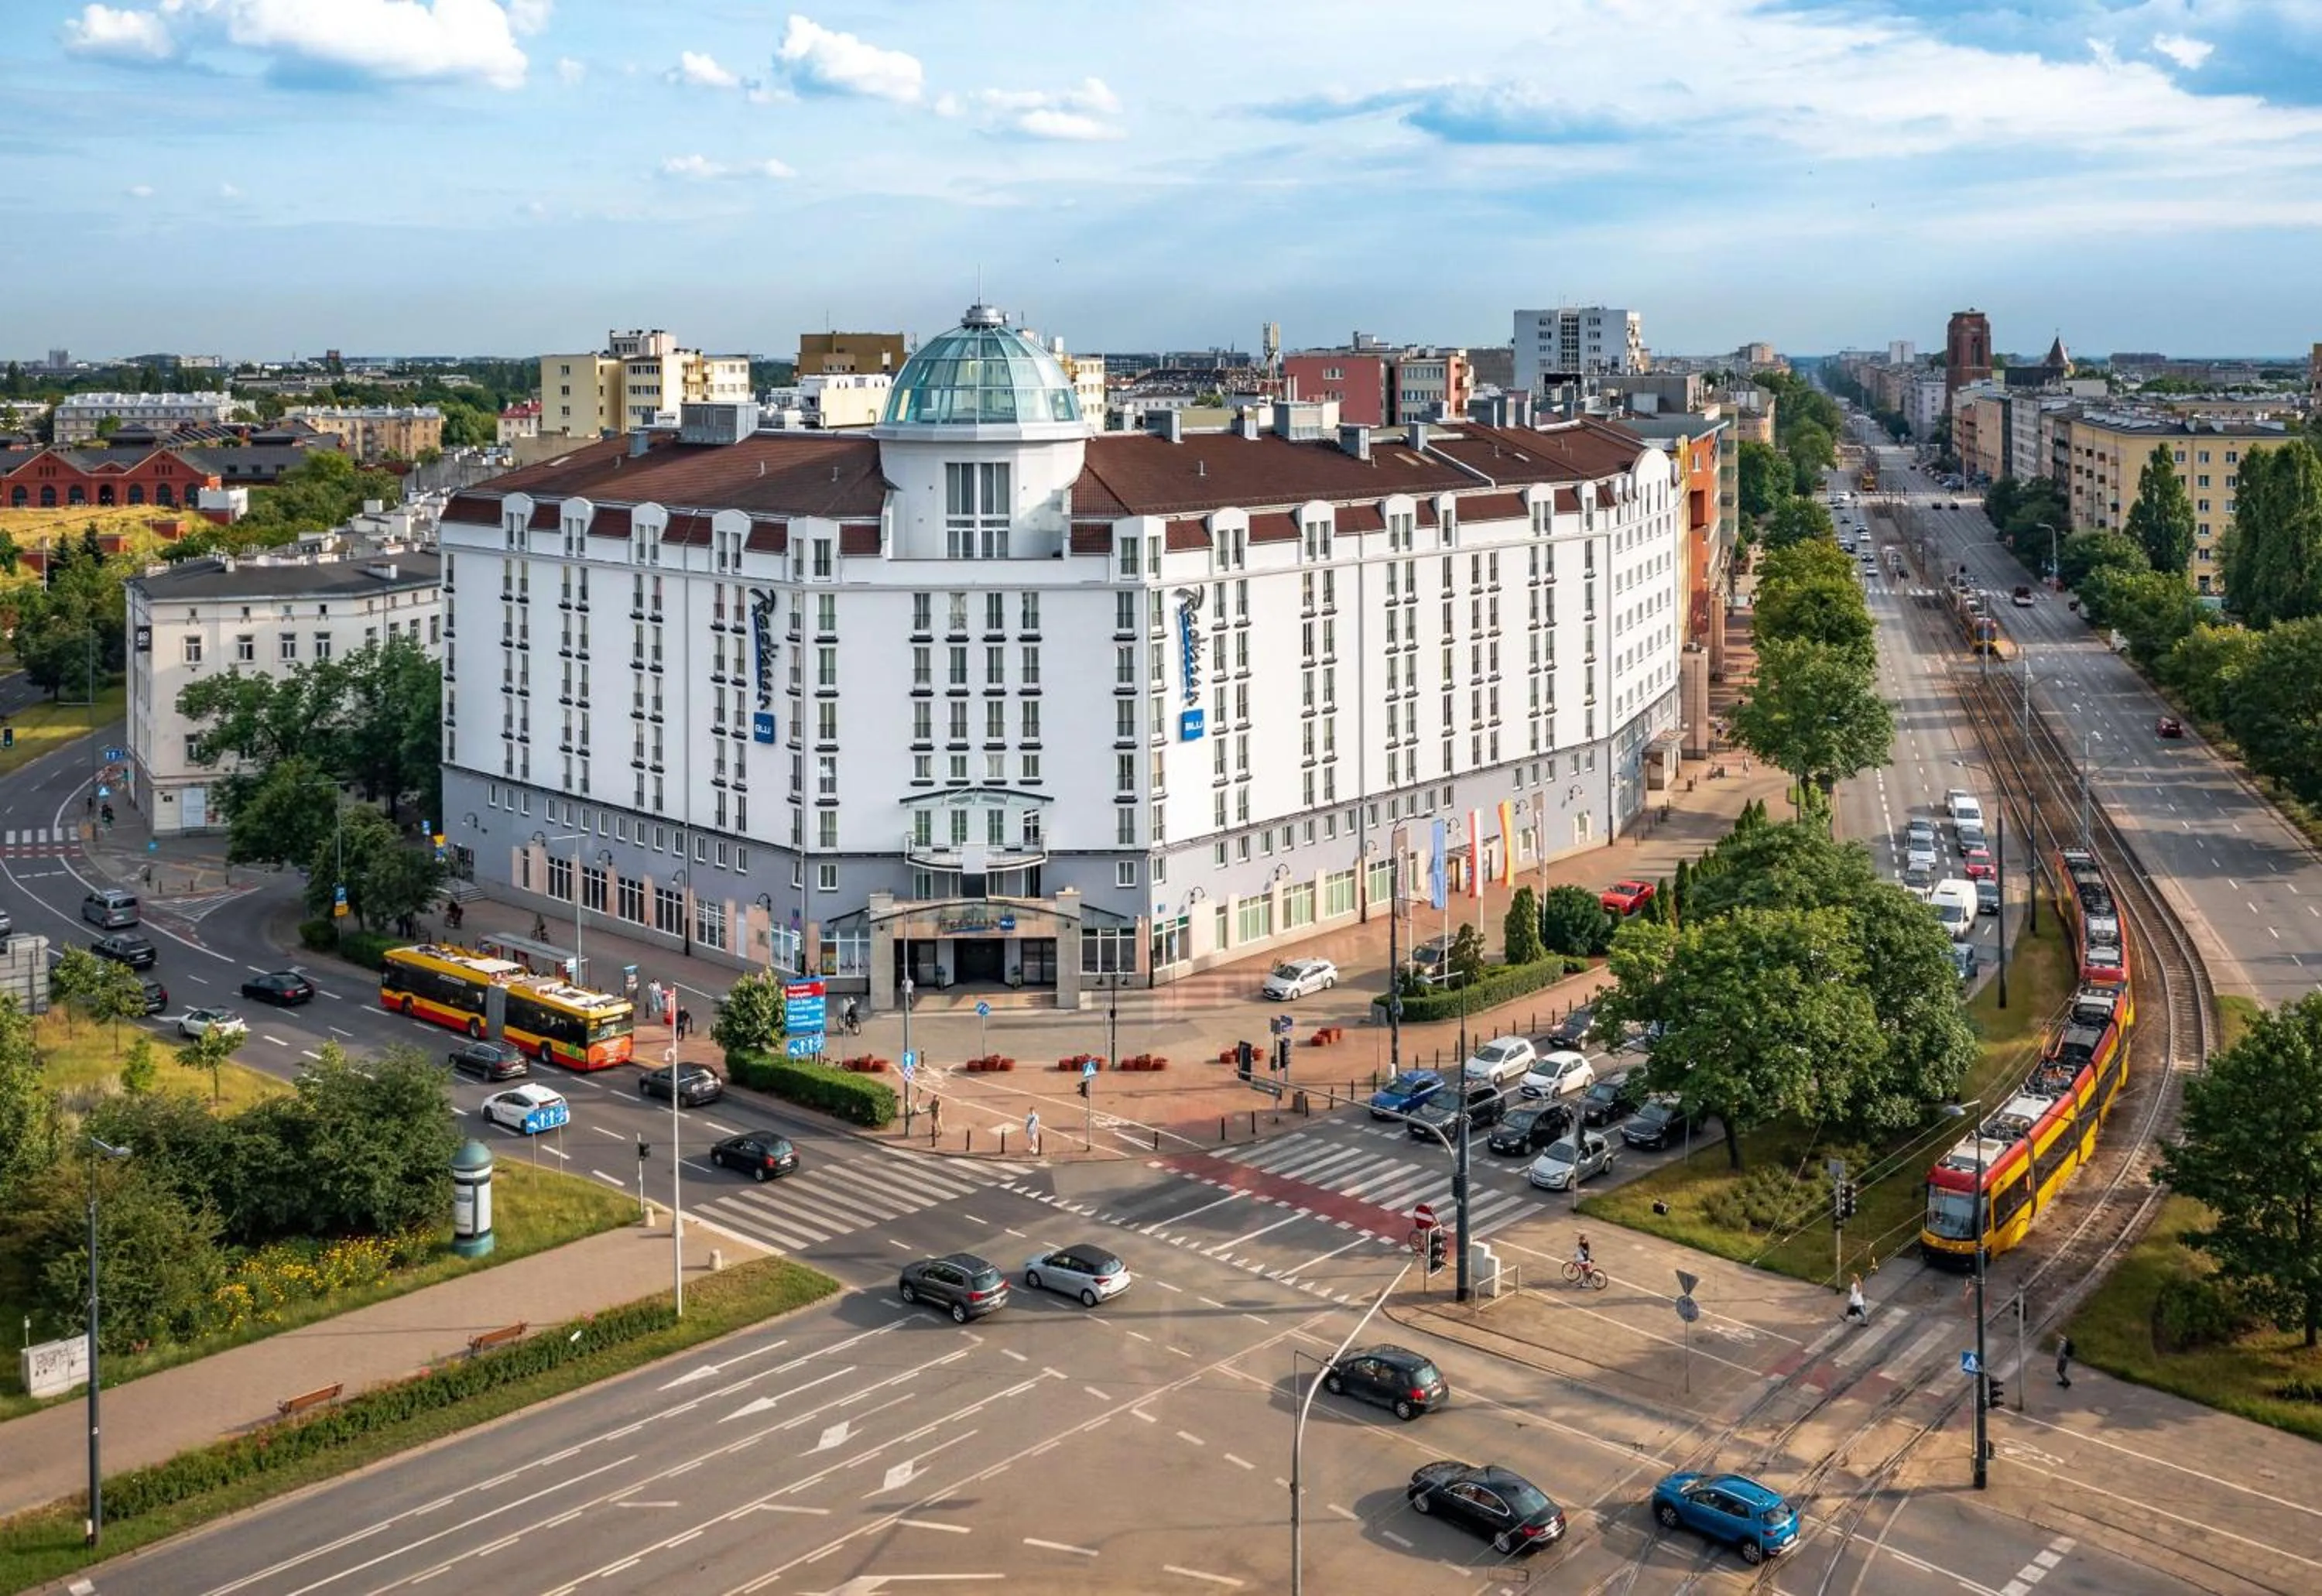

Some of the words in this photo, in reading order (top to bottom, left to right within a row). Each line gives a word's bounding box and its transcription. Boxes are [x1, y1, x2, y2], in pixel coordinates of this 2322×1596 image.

[749, 587, 779, 711] Radisson
[1172, 584, 1209, 707] Radisson
[755, 724, 772, 735] BLU
[1185, 721, 1203, 732] BLU
